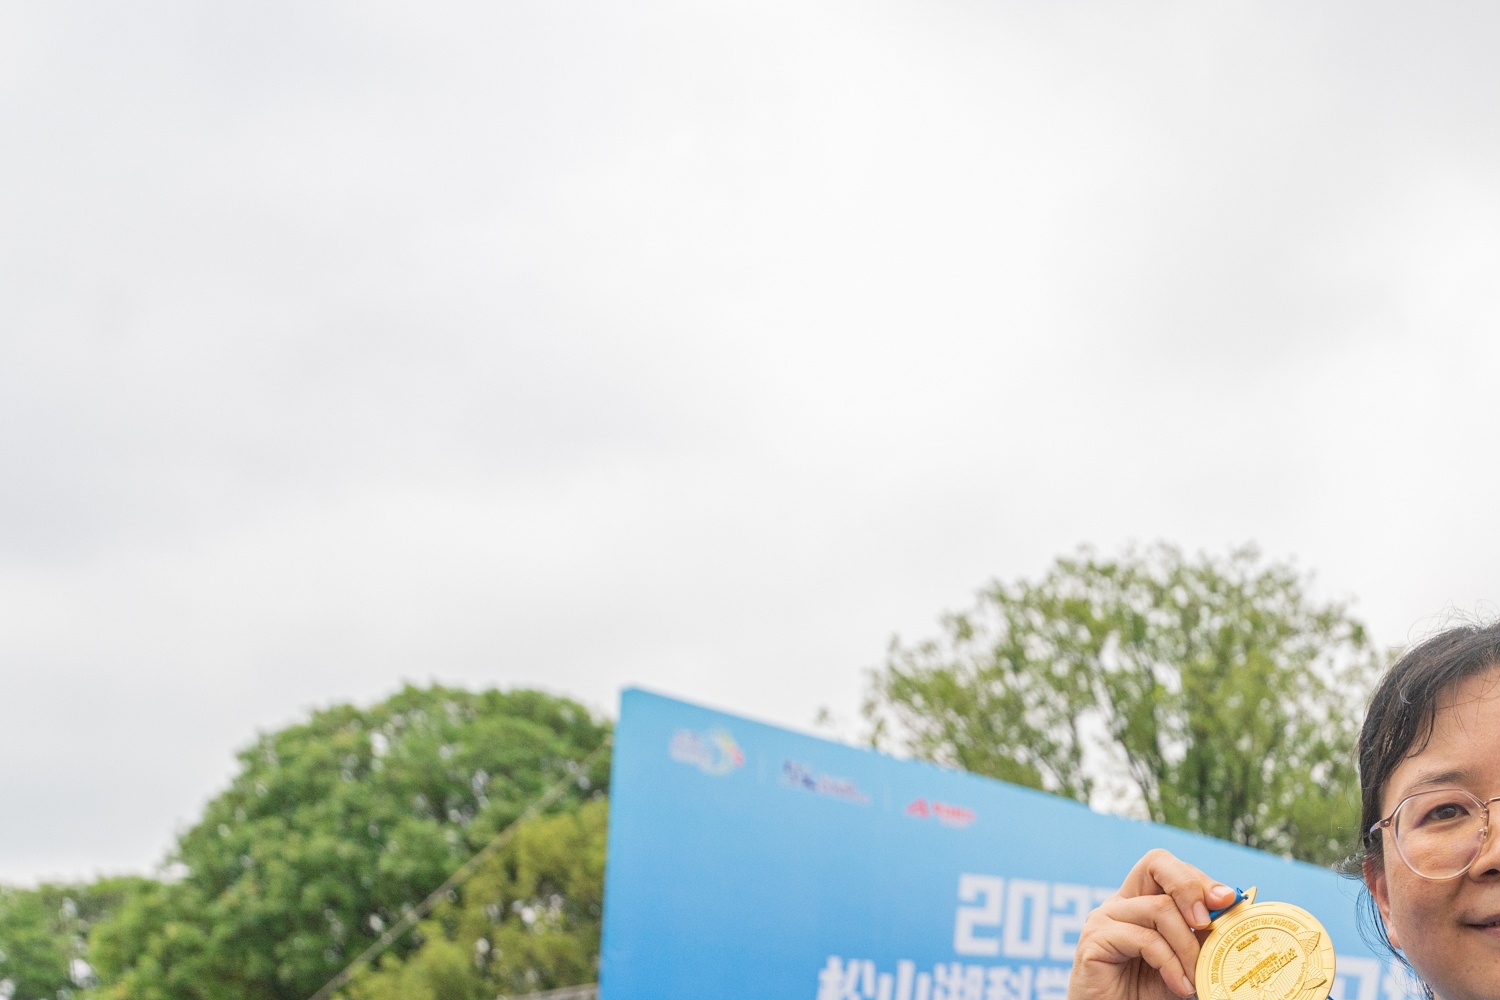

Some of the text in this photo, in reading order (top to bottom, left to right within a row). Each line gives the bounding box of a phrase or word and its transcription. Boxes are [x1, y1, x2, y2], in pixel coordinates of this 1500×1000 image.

[1221, 933, 1234, 947] LAKE
[1231, 921, 1250, 936] SCIENCE
[1249, 918, 1261, 928] CITY
[1260, 917, 1273, 925] HALF
[1273, 917, 1299, 932] MARATHON
